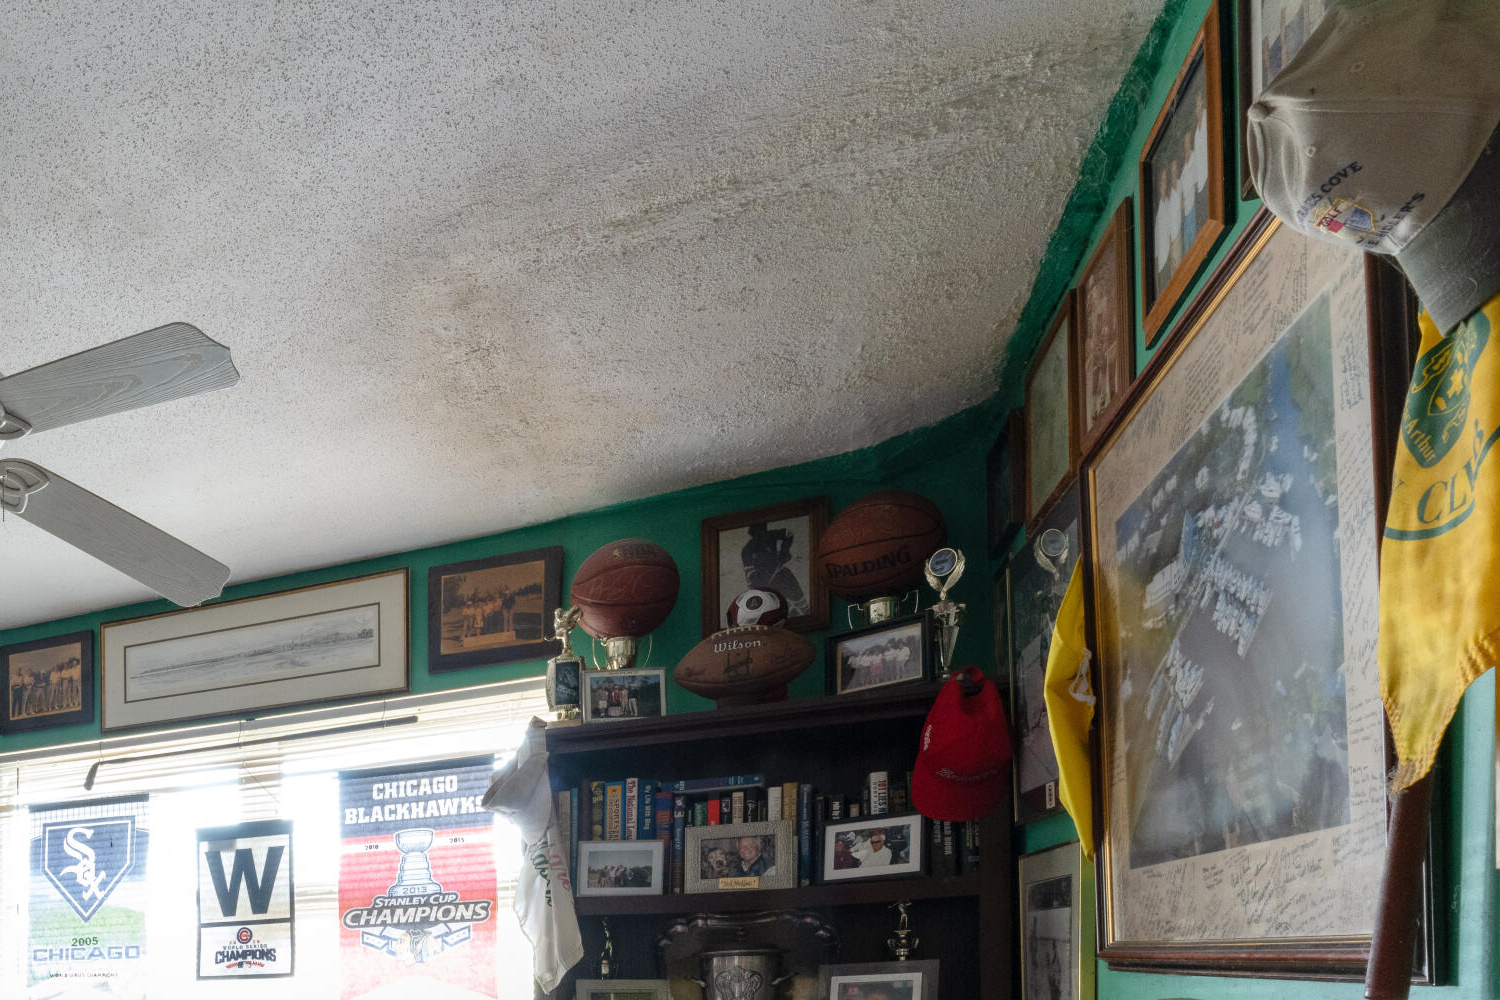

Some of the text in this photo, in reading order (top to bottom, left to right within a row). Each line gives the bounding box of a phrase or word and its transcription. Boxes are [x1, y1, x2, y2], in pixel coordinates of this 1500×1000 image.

[1321, 161, 1362, 193] COVE
[825, 549, 913, 578] SPALDING
[714, 638, 762, 653] Wilson
[372, 775, 458, 800] CHICAGO
[627, 780, 636, 825] The National
[878, 791, 886, 806] LIES
[345, 795, 486, 824] BLACKHAWKS
[205, 846, 285, 917] W
[402, 886, 427, 895] 2013
[375, 893, 458, 908] STANLEY CUP
[345, 902, 490, 927] CHAMPIONS
[71, 936, 98, 947] 2005
[33, 945, 140, 962] CHICAGO
[215, 948, 276, 965] CHAMPIONS
